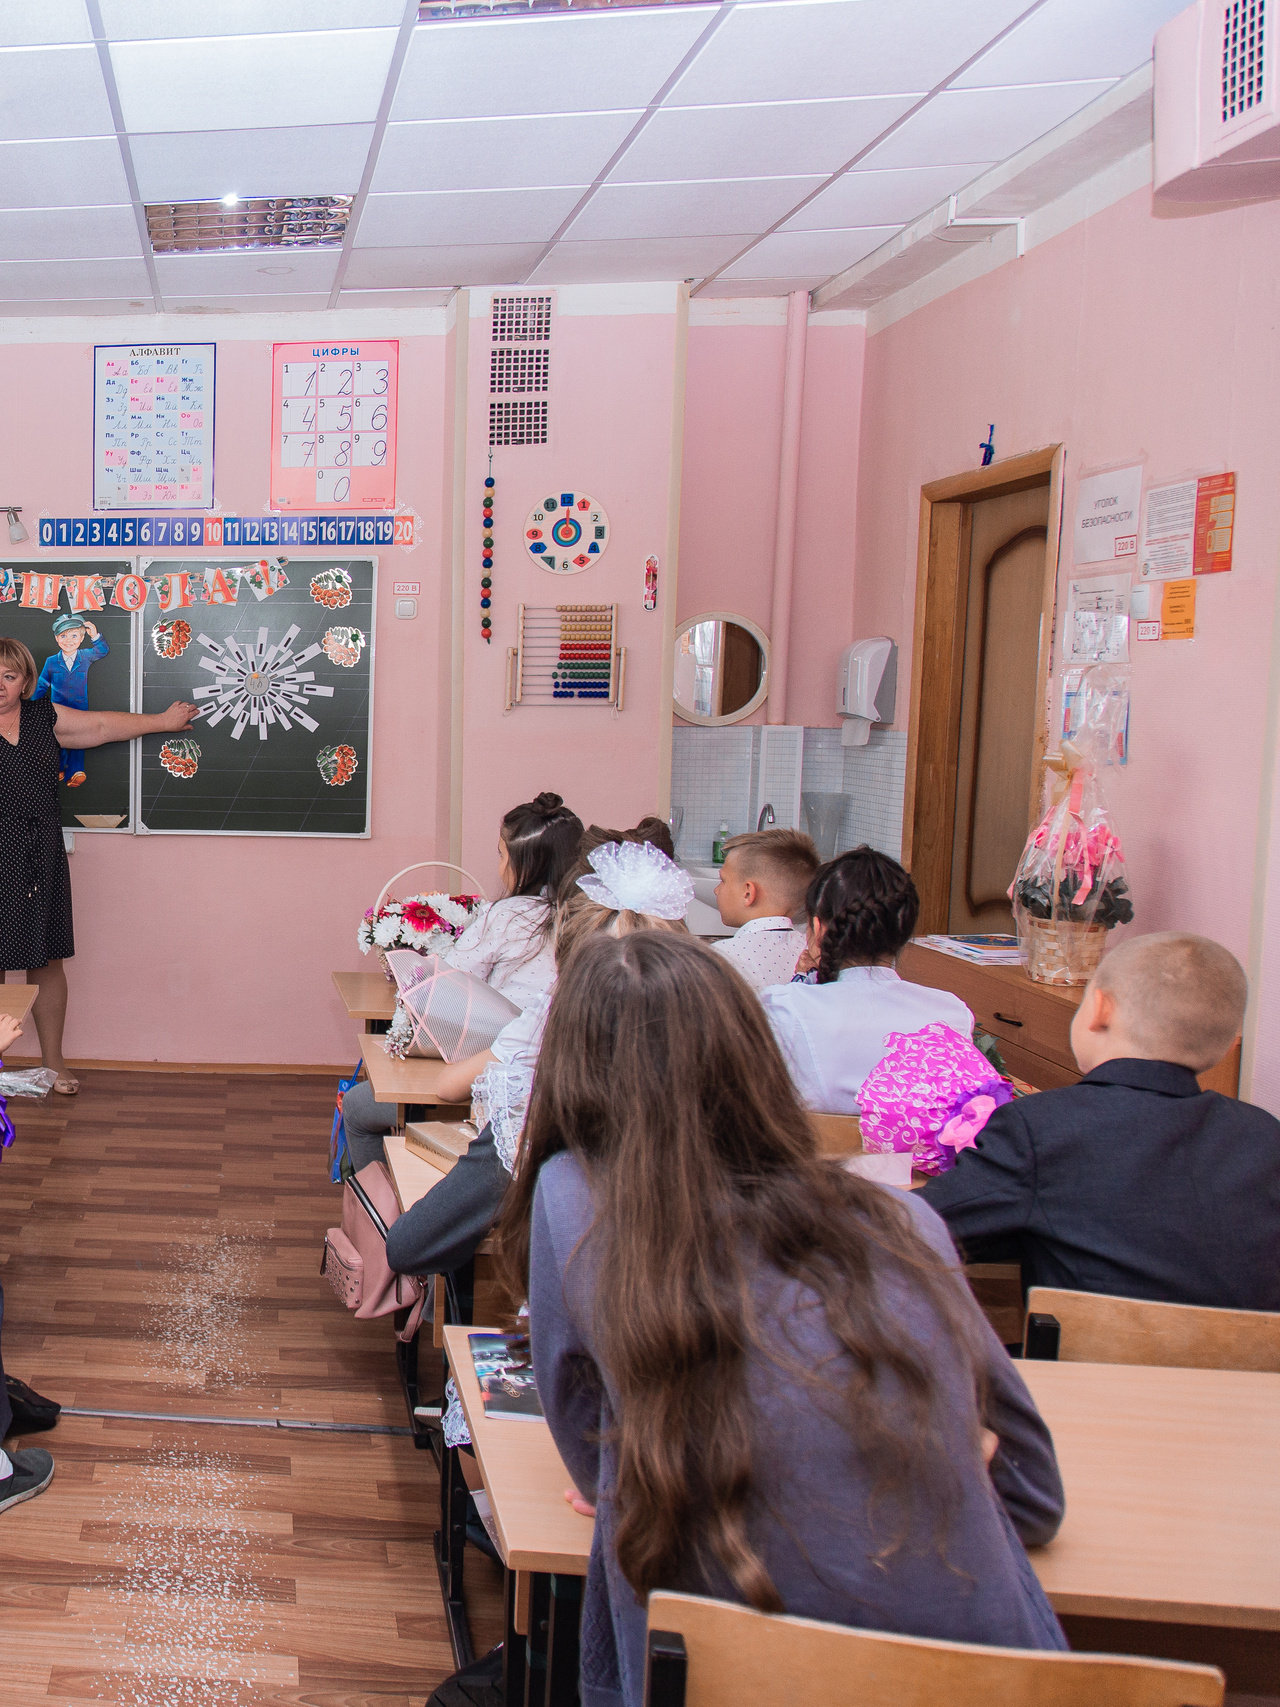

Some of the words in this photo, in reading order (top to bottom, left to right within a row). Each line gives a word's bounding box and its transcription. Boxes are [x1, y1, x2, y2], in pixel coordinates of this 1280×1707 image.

[129, 348, 181, 357] АЛФАВИТ
[313, 348, 360, 358] ЦИФРЫ
[284, 365, 289, 373] 1
[320, 363, 326, 372] 2
[356, 363, 361, 372] 3
[305, 370, 316, 396] 1
[337, 369, 352, 395] 2
[373, 368, 389, 394] 3
[283, 400, 289, 408] 4
[319, 399, 325, 407] 5
[355, 398, 361, 407] 6
[302, 406, 316, 432] 4
[337, 405, 352, 431] 5
[371, 404, 388, 430] 6
[283, 436, 288, 444] 7
[319, 435, 324, 443] 8
[354, 434, 360, 442] 9
[302, 442, 315, 467] 7
[335, 440, 351, 466] 8
[370, 440, 387, 466] 9
[318, 470, 323, 479] 0
[334, 476, 350, 502] 0
[1094, 496, 1118, 509] УГОЛОК
[593, 514, 599, 522] 2
[1081, 511, 1133, 528] БЕЗОПАСНОСТИ
[43, 523, 52, 542] 0
[60, 523, 67, 542] 1
[75, 523, 85, 542] 2
[91, 523, 101, 542] 3
[108, 523, 118, 542] 4
[124, 523, 133, 542] 5
[140, 522, 151, 542] 6
[158, 523, 167, 542] 7
[173, 522, 184, 542] 8
[191, 522, 201, 542] 9
[206, 522, 221, 542] 10
[225, 522, 239, 541] 11
[244, 522, 259, 541] 12
[263, 522, 278, 541] 13
[282, 522, 298, 541] 14
[301, 522, 317, 541] 15
[320, 521, 336, 541] 16
[339, 521, 355, 541] 17
[357, 521, 374, 541] 18
[376, 521, 393, 541] 19
[395, 521, 412, 541] 20
[532, 530, 538, 538] 9
[535, 544, 542, 552] 8
[1118, 542, 1128, 551] 220
[562, 561, 568, 569] 6
[1140, 626, 1150, 635] 220
